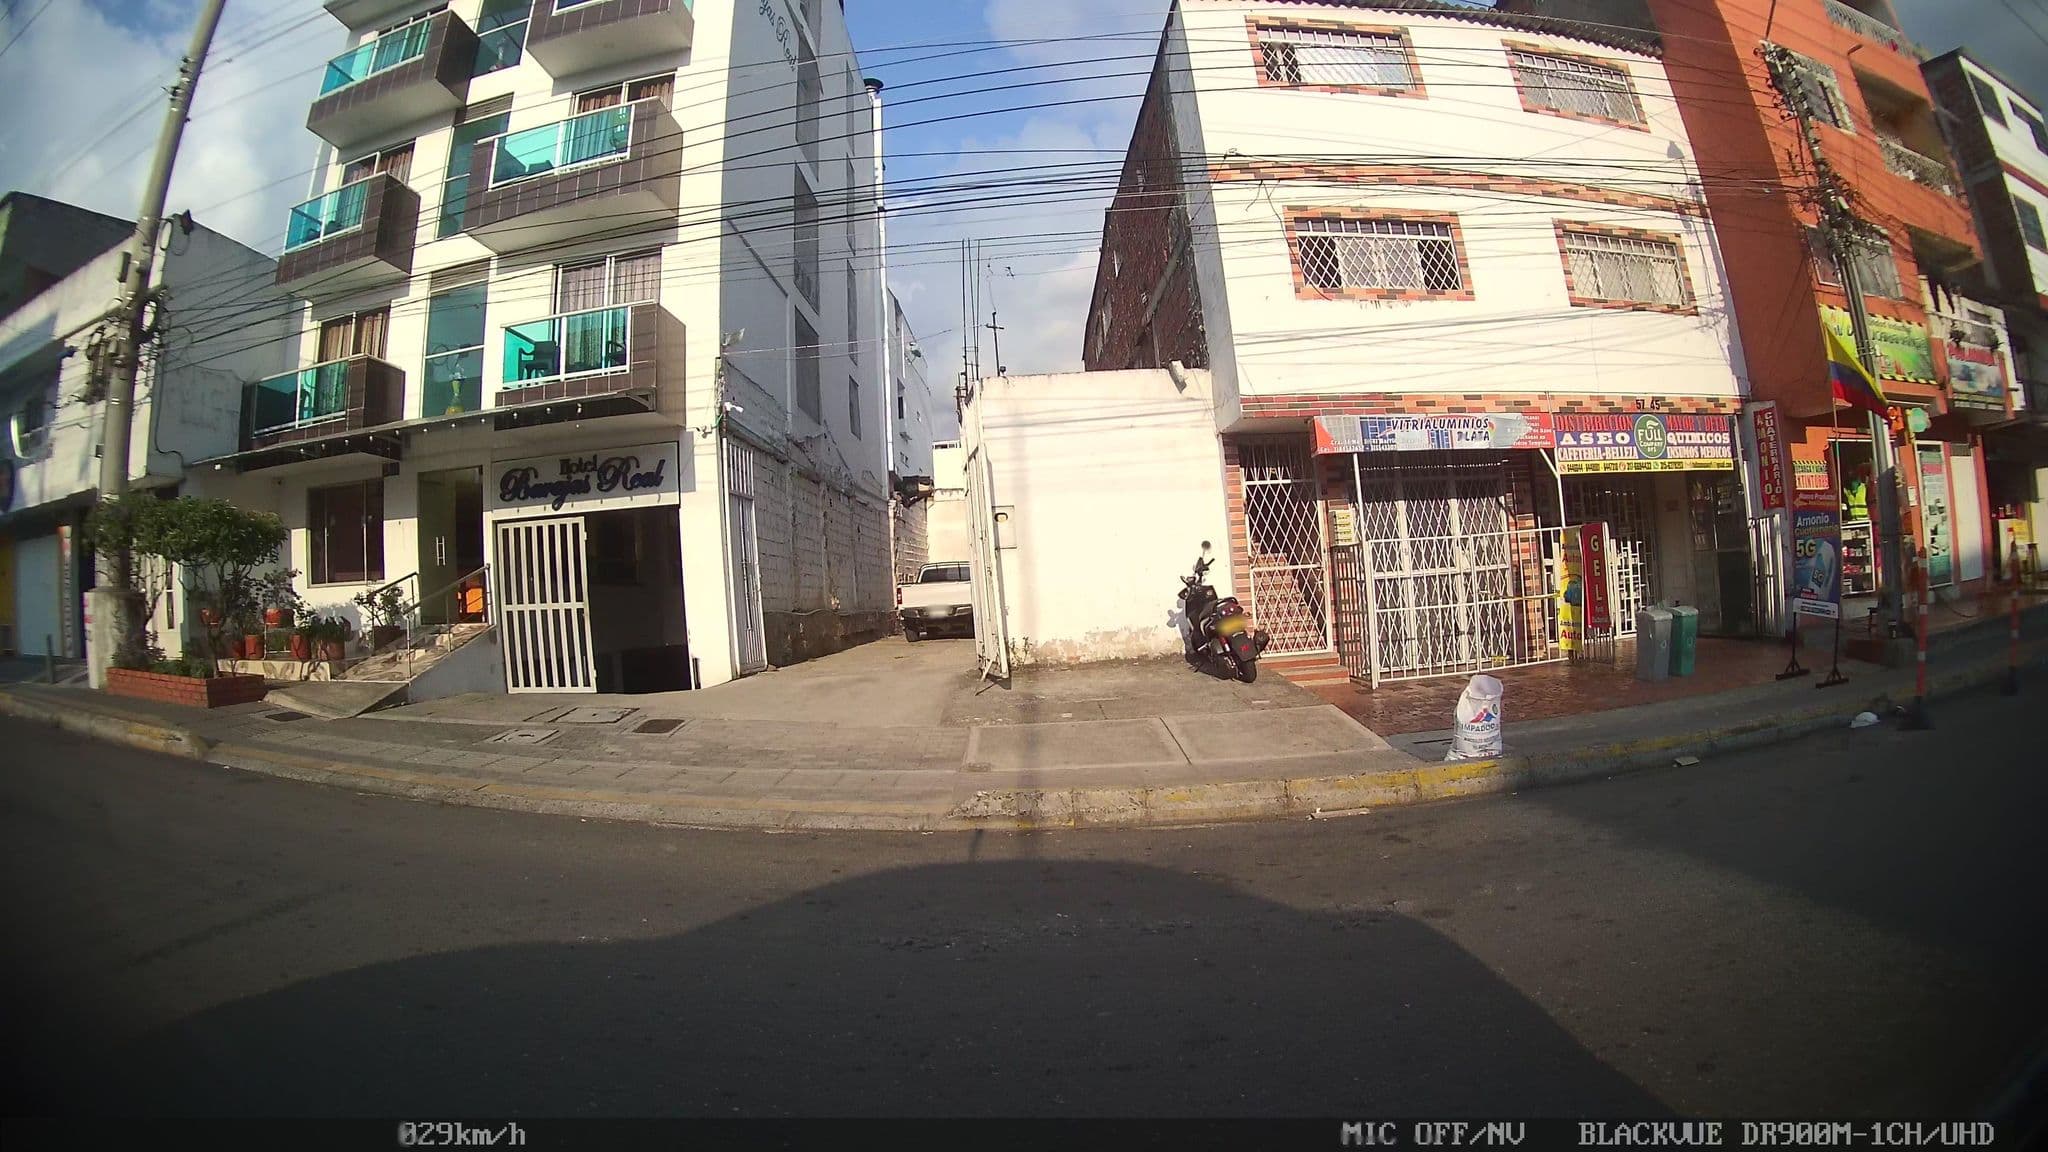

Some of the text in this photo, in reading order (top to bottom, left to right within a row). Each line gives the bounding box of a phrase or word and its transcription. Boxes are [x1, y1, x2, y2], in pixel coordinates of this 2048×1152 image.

[1635, 399, 1661, 411] 57 45
[1391, 417, 1489, 431] VITRIALUMINIOS
[1556, 414, 1633, 432] DISTRIBUCION
[1666, 415, 1695, 431] MAYOR
[1696, 415, 1702, 431] Y
[1559, 432, 1632, 446] ASEO
[1667, 432, 1730, 447] QUIMICOS
[1667, 445, 1732, 460] INSUMOS MEDICOS
[1756, 414, 1773, 495] AMONIO
[1764, 411, 1782, 494] CUATERNARIO
[559, 454, 598, 476] Hotel
[596, 455, 664, 493] Real
[1796, 513, 1830, 527] Amonio
[1796, 539, 1817, 558] 5G
[1591, 535, 1603, 601] GEL
